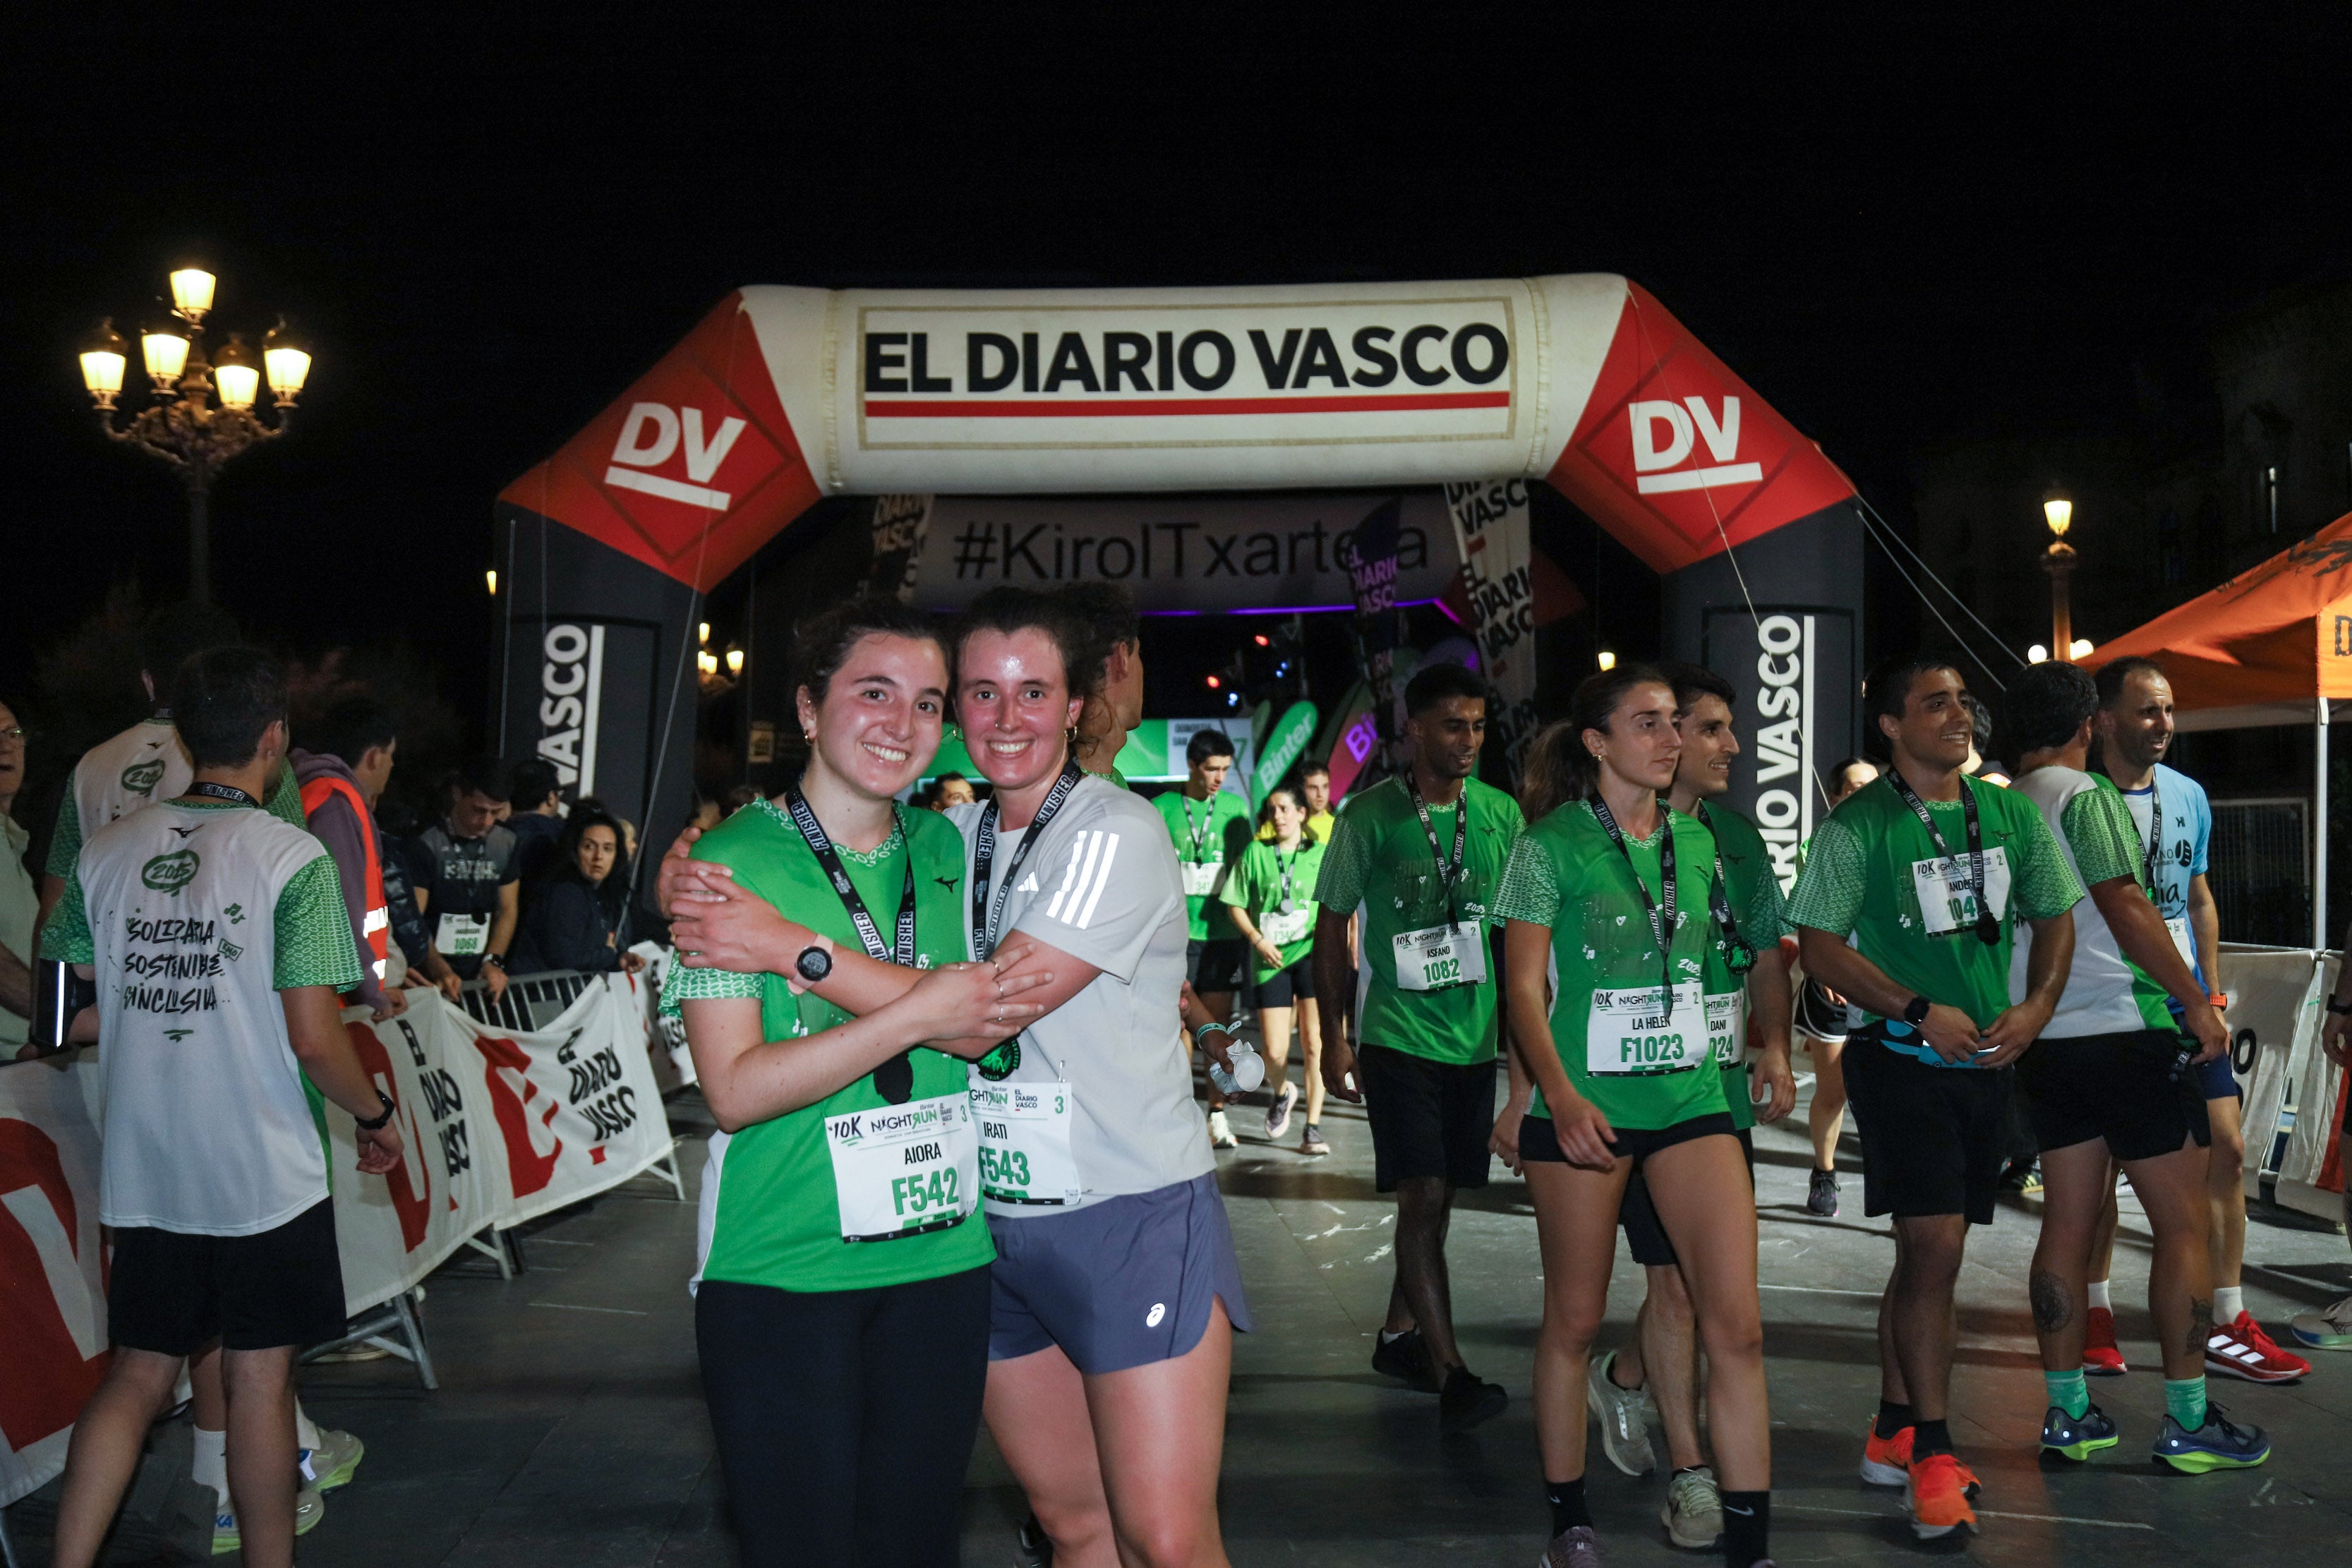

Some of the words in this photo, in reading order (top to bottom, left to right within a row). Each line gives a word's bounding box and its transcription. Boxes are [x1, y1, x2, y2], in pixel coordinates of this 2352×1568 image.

[866, 332, 952, 392] EL
[967, 330, 1236, 392] DIARIO
[1247, 322, 1509, 390] VASCO
[611, 402, 747, 483] DV
[1629, 396, 1741, 472] DV
[953, 520, 1428, 580] #KirolTxartea
[1757, 615, 1801, 783] VASCO
[1260, 711, 1311, 790] Binter
[202, 784, 246, 802] FINISHER
[1036, 775, 1074, 824] FINISHER
[1413, 793, 1430, 822] FINISHER
[1905, 792, 1931, 822] FINISHER
[791, 800, 830, 851] FINISHER
[977, 810, 995, 858] FINISHER
[2152, 814, 2161, 843] FINISHER
[1454, 833, 1464, 863] FINISHER
[1756, 789, 1799, 900] RIO
[1917, 860, 1936, 875] 10K
[1997, 855, 2003, 865] 2
[1972, 852, 1984, 887] FINISHER
[989, 885, 1008, 941] FINISHER
[1663, 881, 1675, 920] FINISHER
[1948, 895, 1987, 921] 104
[854, 912, 890, 963] INISHER
[897, 911, 914, 967] FINISHER
[1397, 934, 1412, 946] 10K
[1471, 927, 1476, 936] 2
[1427, 946, 1450, 958] ASFAND
[1423, 958, 1460, 982] 1082
[1594, 991, 1614, 1008] 10K
[1694, 991, 1699, 1004] 2
[1632, 1018, 1644, 1030] LA
[1646, 1016, 1671, 1029] HELEN
[1711, 1020, 1726, 1031] DANI
[1621, 1034, 1684, 1063] F1023
[833, 1115, 862, 1140] 10K
[960, 1104, 967, 1122] 3
[1055, 1095, 1064, 1114] 3
[983, 1121, 1008, 1139] IRATI
[905, 1142, 941, 1164] AIORA
[978, 1145, 1030, 1186] F543
[891, 1166, 959, 1216] F542
